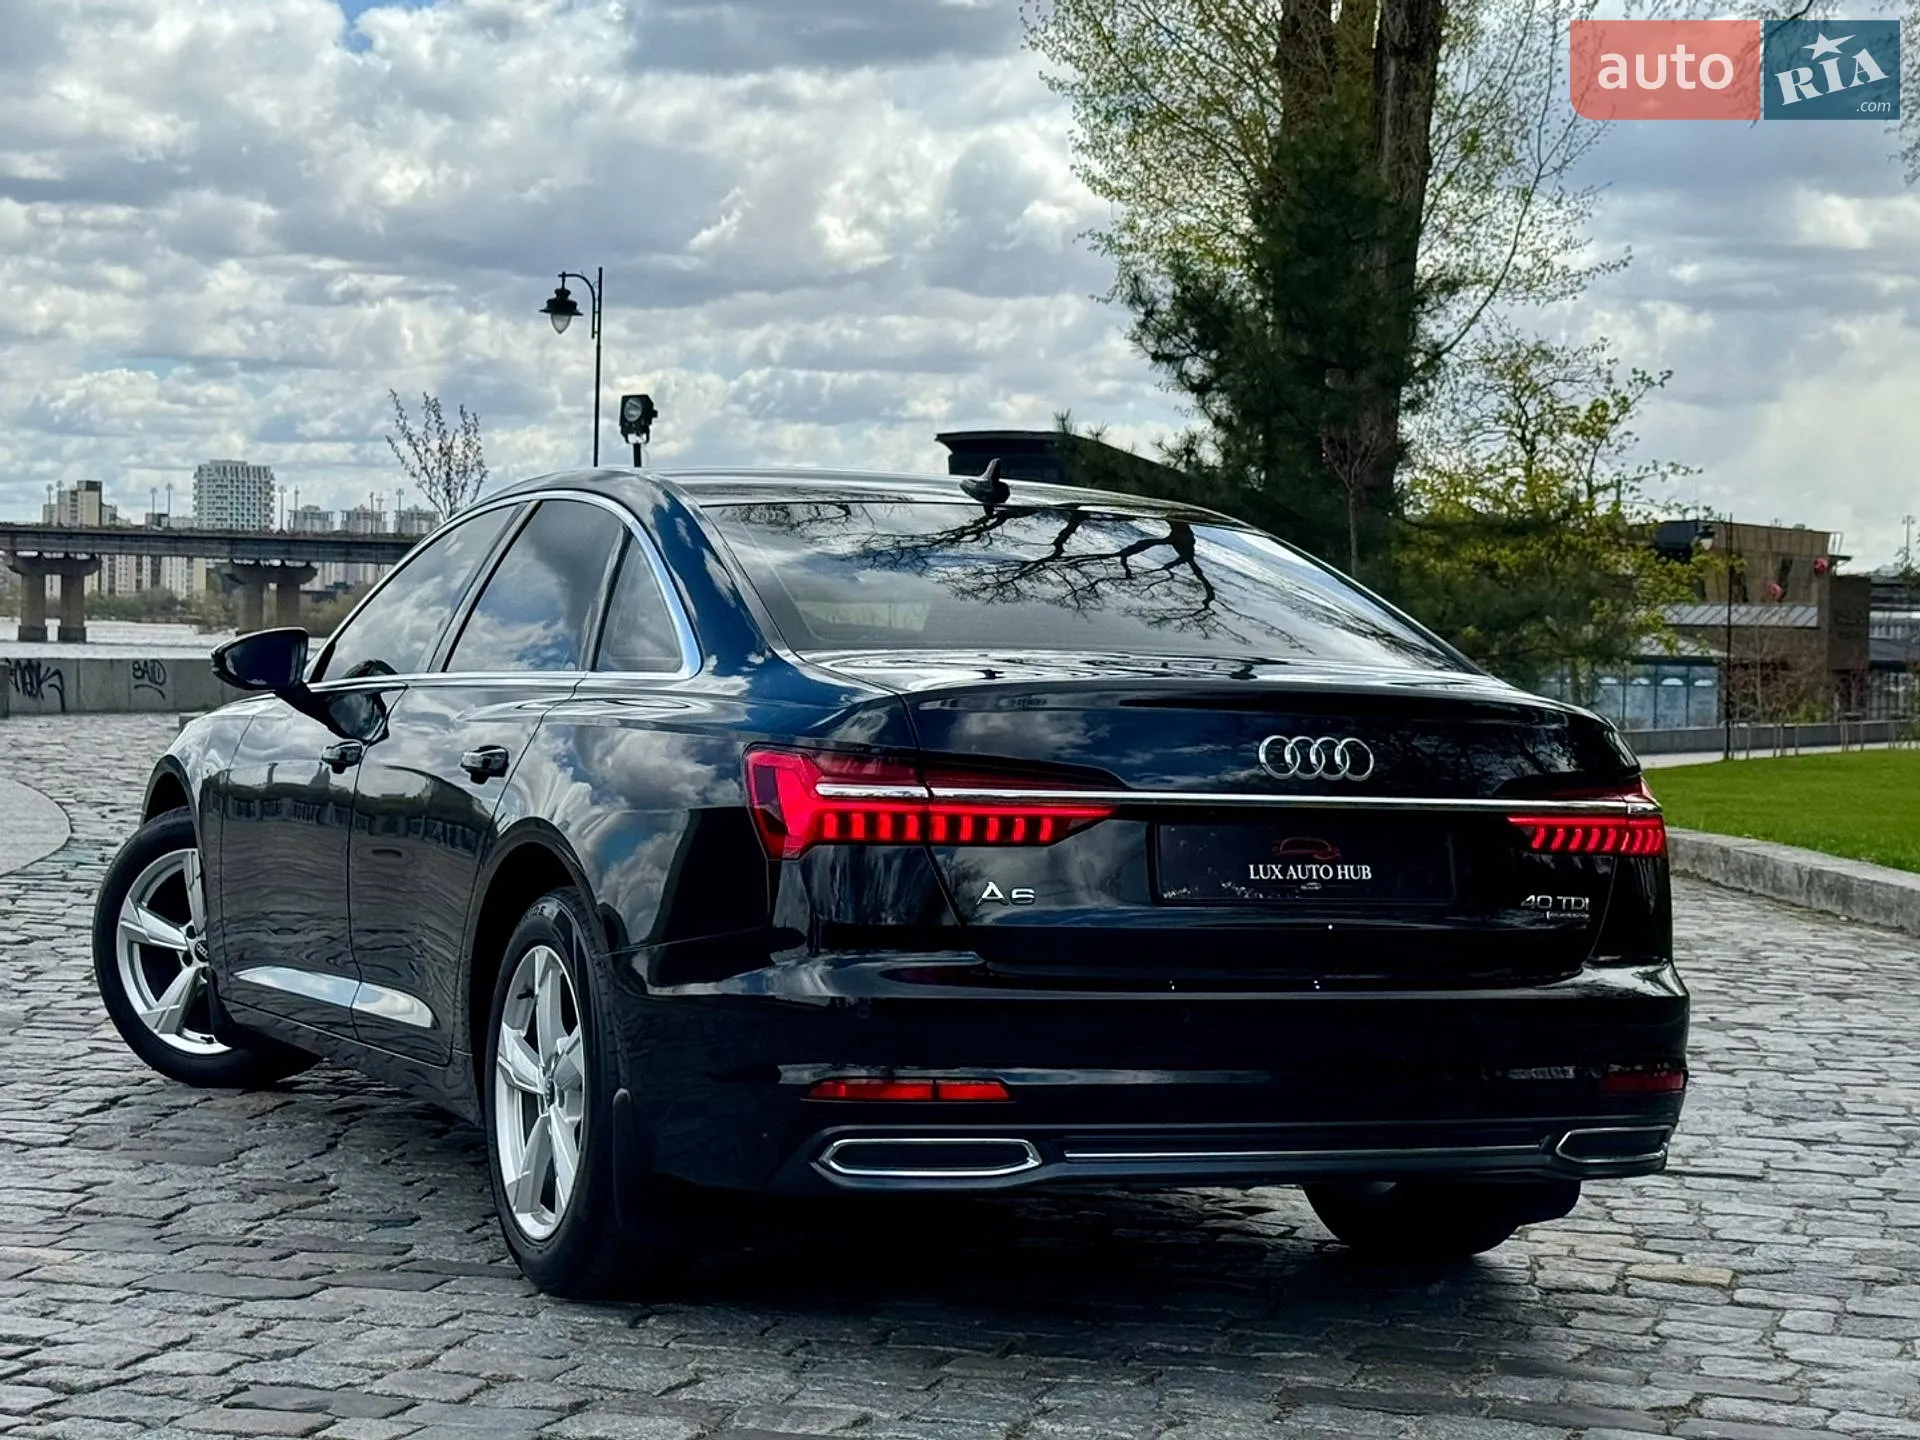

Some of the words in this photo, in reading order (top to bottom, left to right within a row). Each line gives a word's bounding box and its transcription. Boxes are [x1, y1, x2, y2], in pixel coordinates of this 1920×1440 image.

[1249, 864, 1283, 880] LUX
[1286, 864, 1333, 880] AUTO
[1336, 864, 1372, 880] HUB
[976, 881, 1036, 905] A6
[1521, 895, 1553, 909] 40
[1556, 896, 1590, 910] TDI
